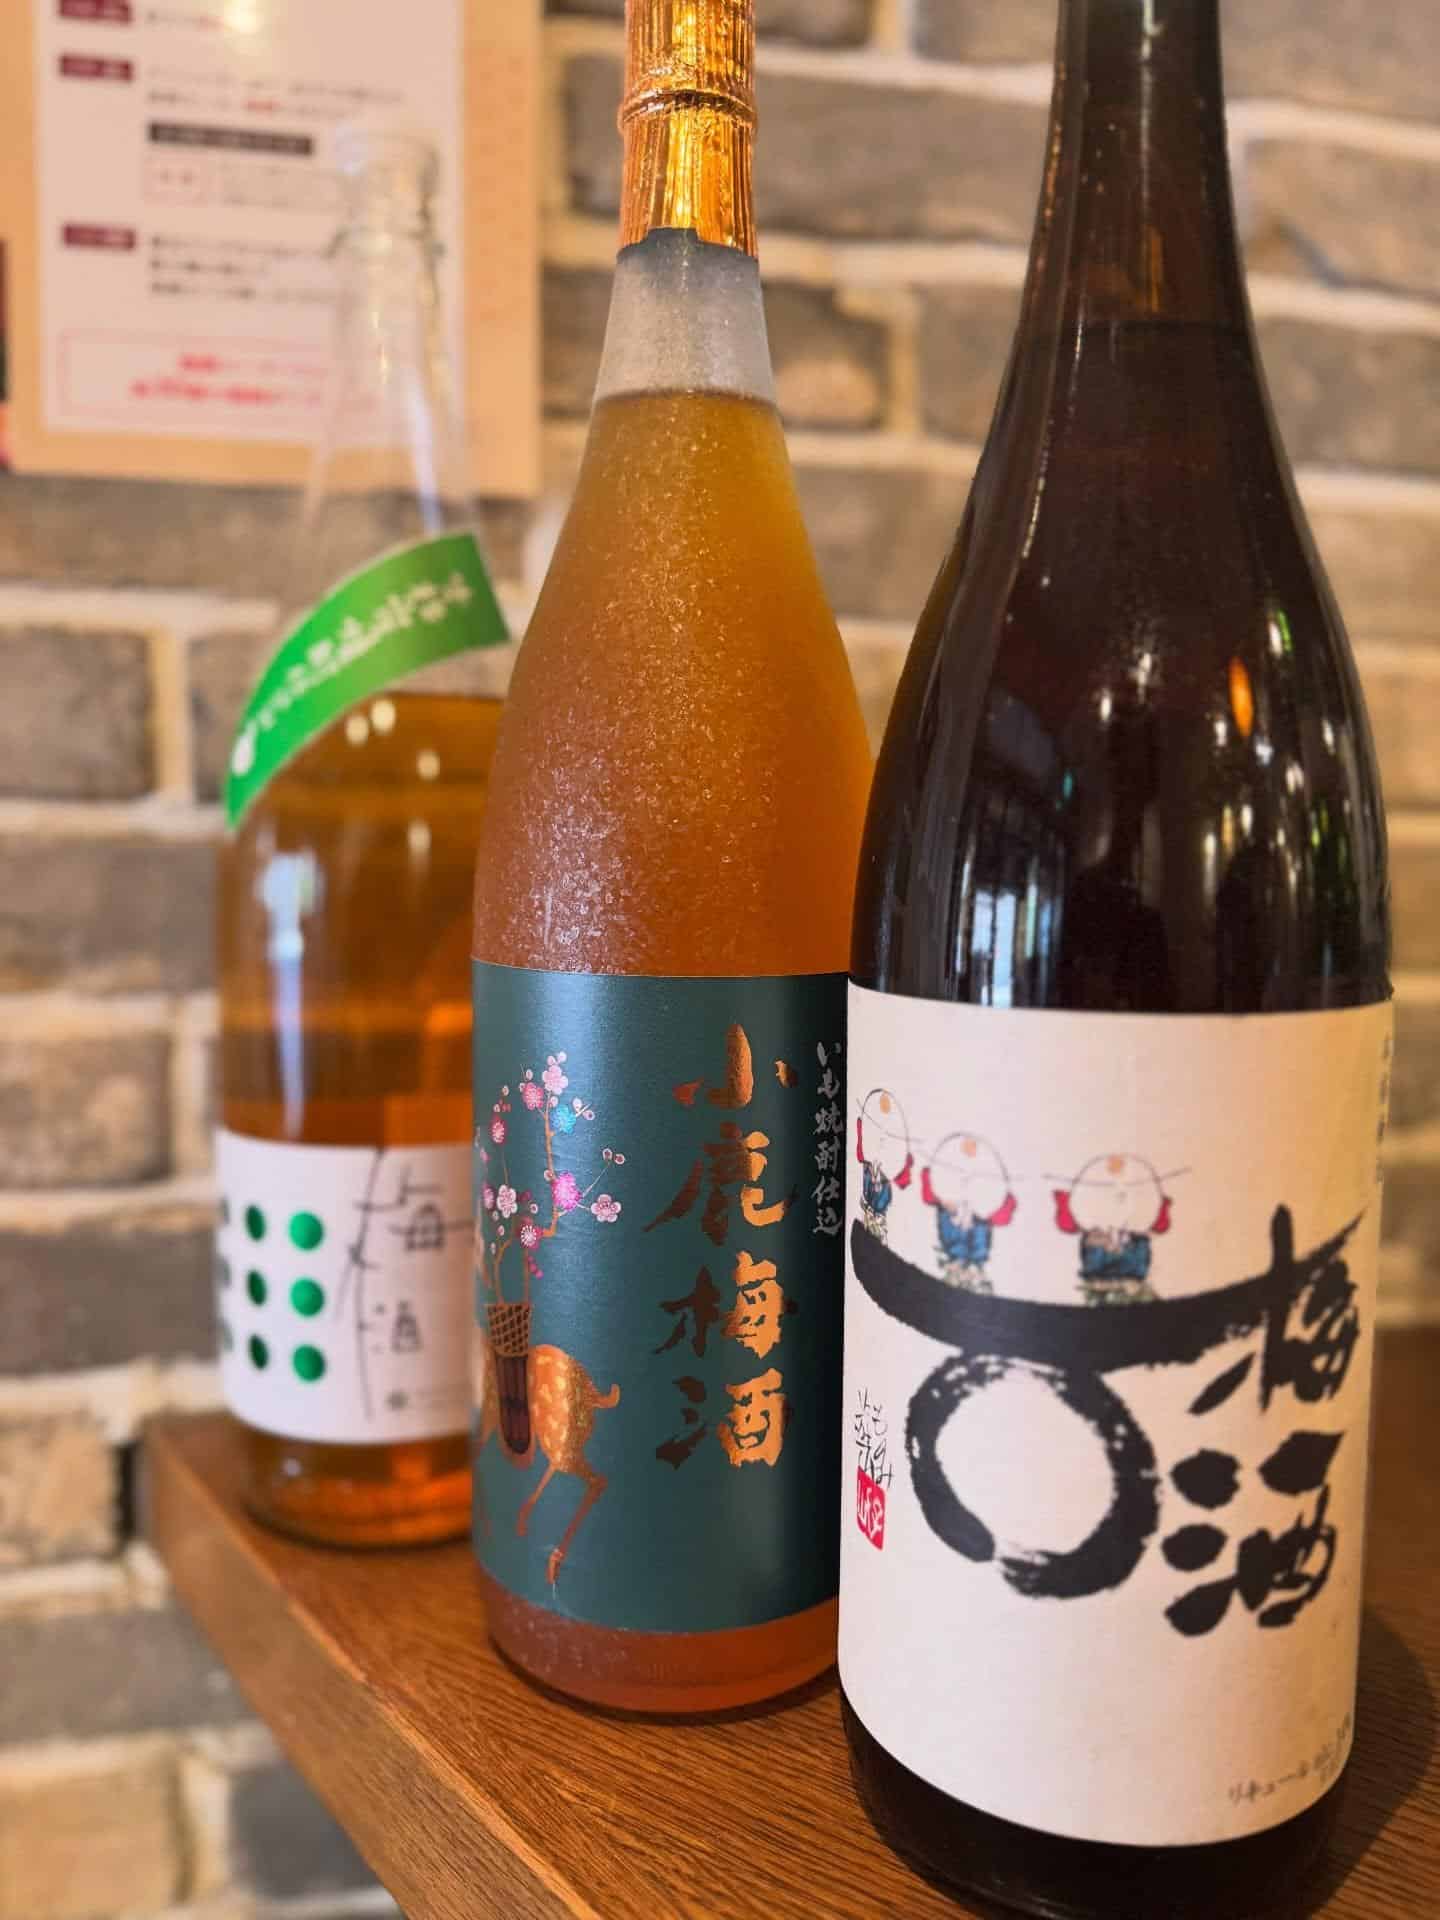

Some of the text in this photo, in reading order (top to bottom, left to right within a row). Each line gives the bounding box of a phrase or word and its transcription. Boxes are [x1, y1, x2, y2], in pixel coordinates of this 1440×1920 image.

[644, 1024, 799, 1468] 小鹿梅酒
[811, 1041, 845, 1236] いも焼酎仕込
